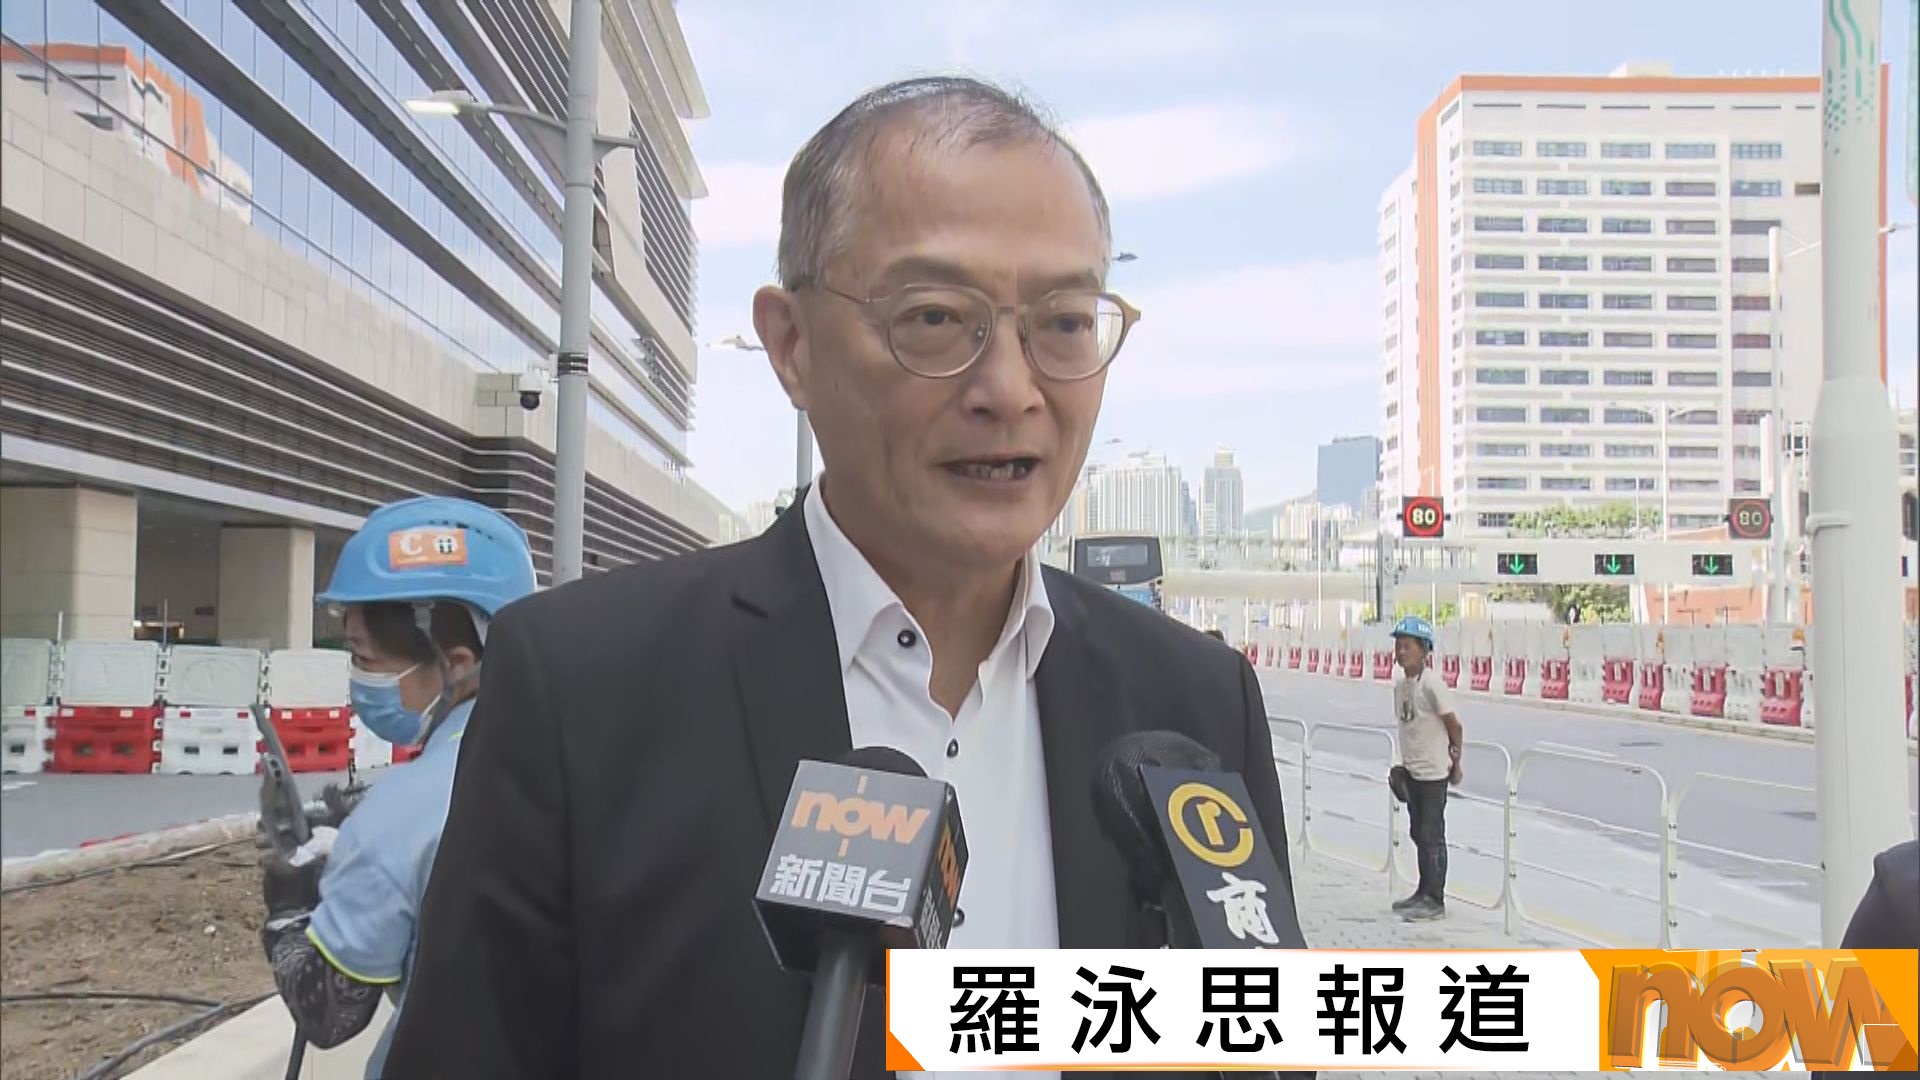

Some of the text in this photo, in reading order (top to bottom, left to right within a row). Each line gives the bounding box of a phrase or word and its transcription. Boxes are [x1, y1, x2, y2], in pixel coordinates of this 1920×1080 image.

[1412, 508, 1435, 526] 80
[1740, 511, 1762, 525] 80
[791, 790, 930, 844] now
[769, 853, 911, 914] 新聞台
[1206, 871, 1280, 949] 商
